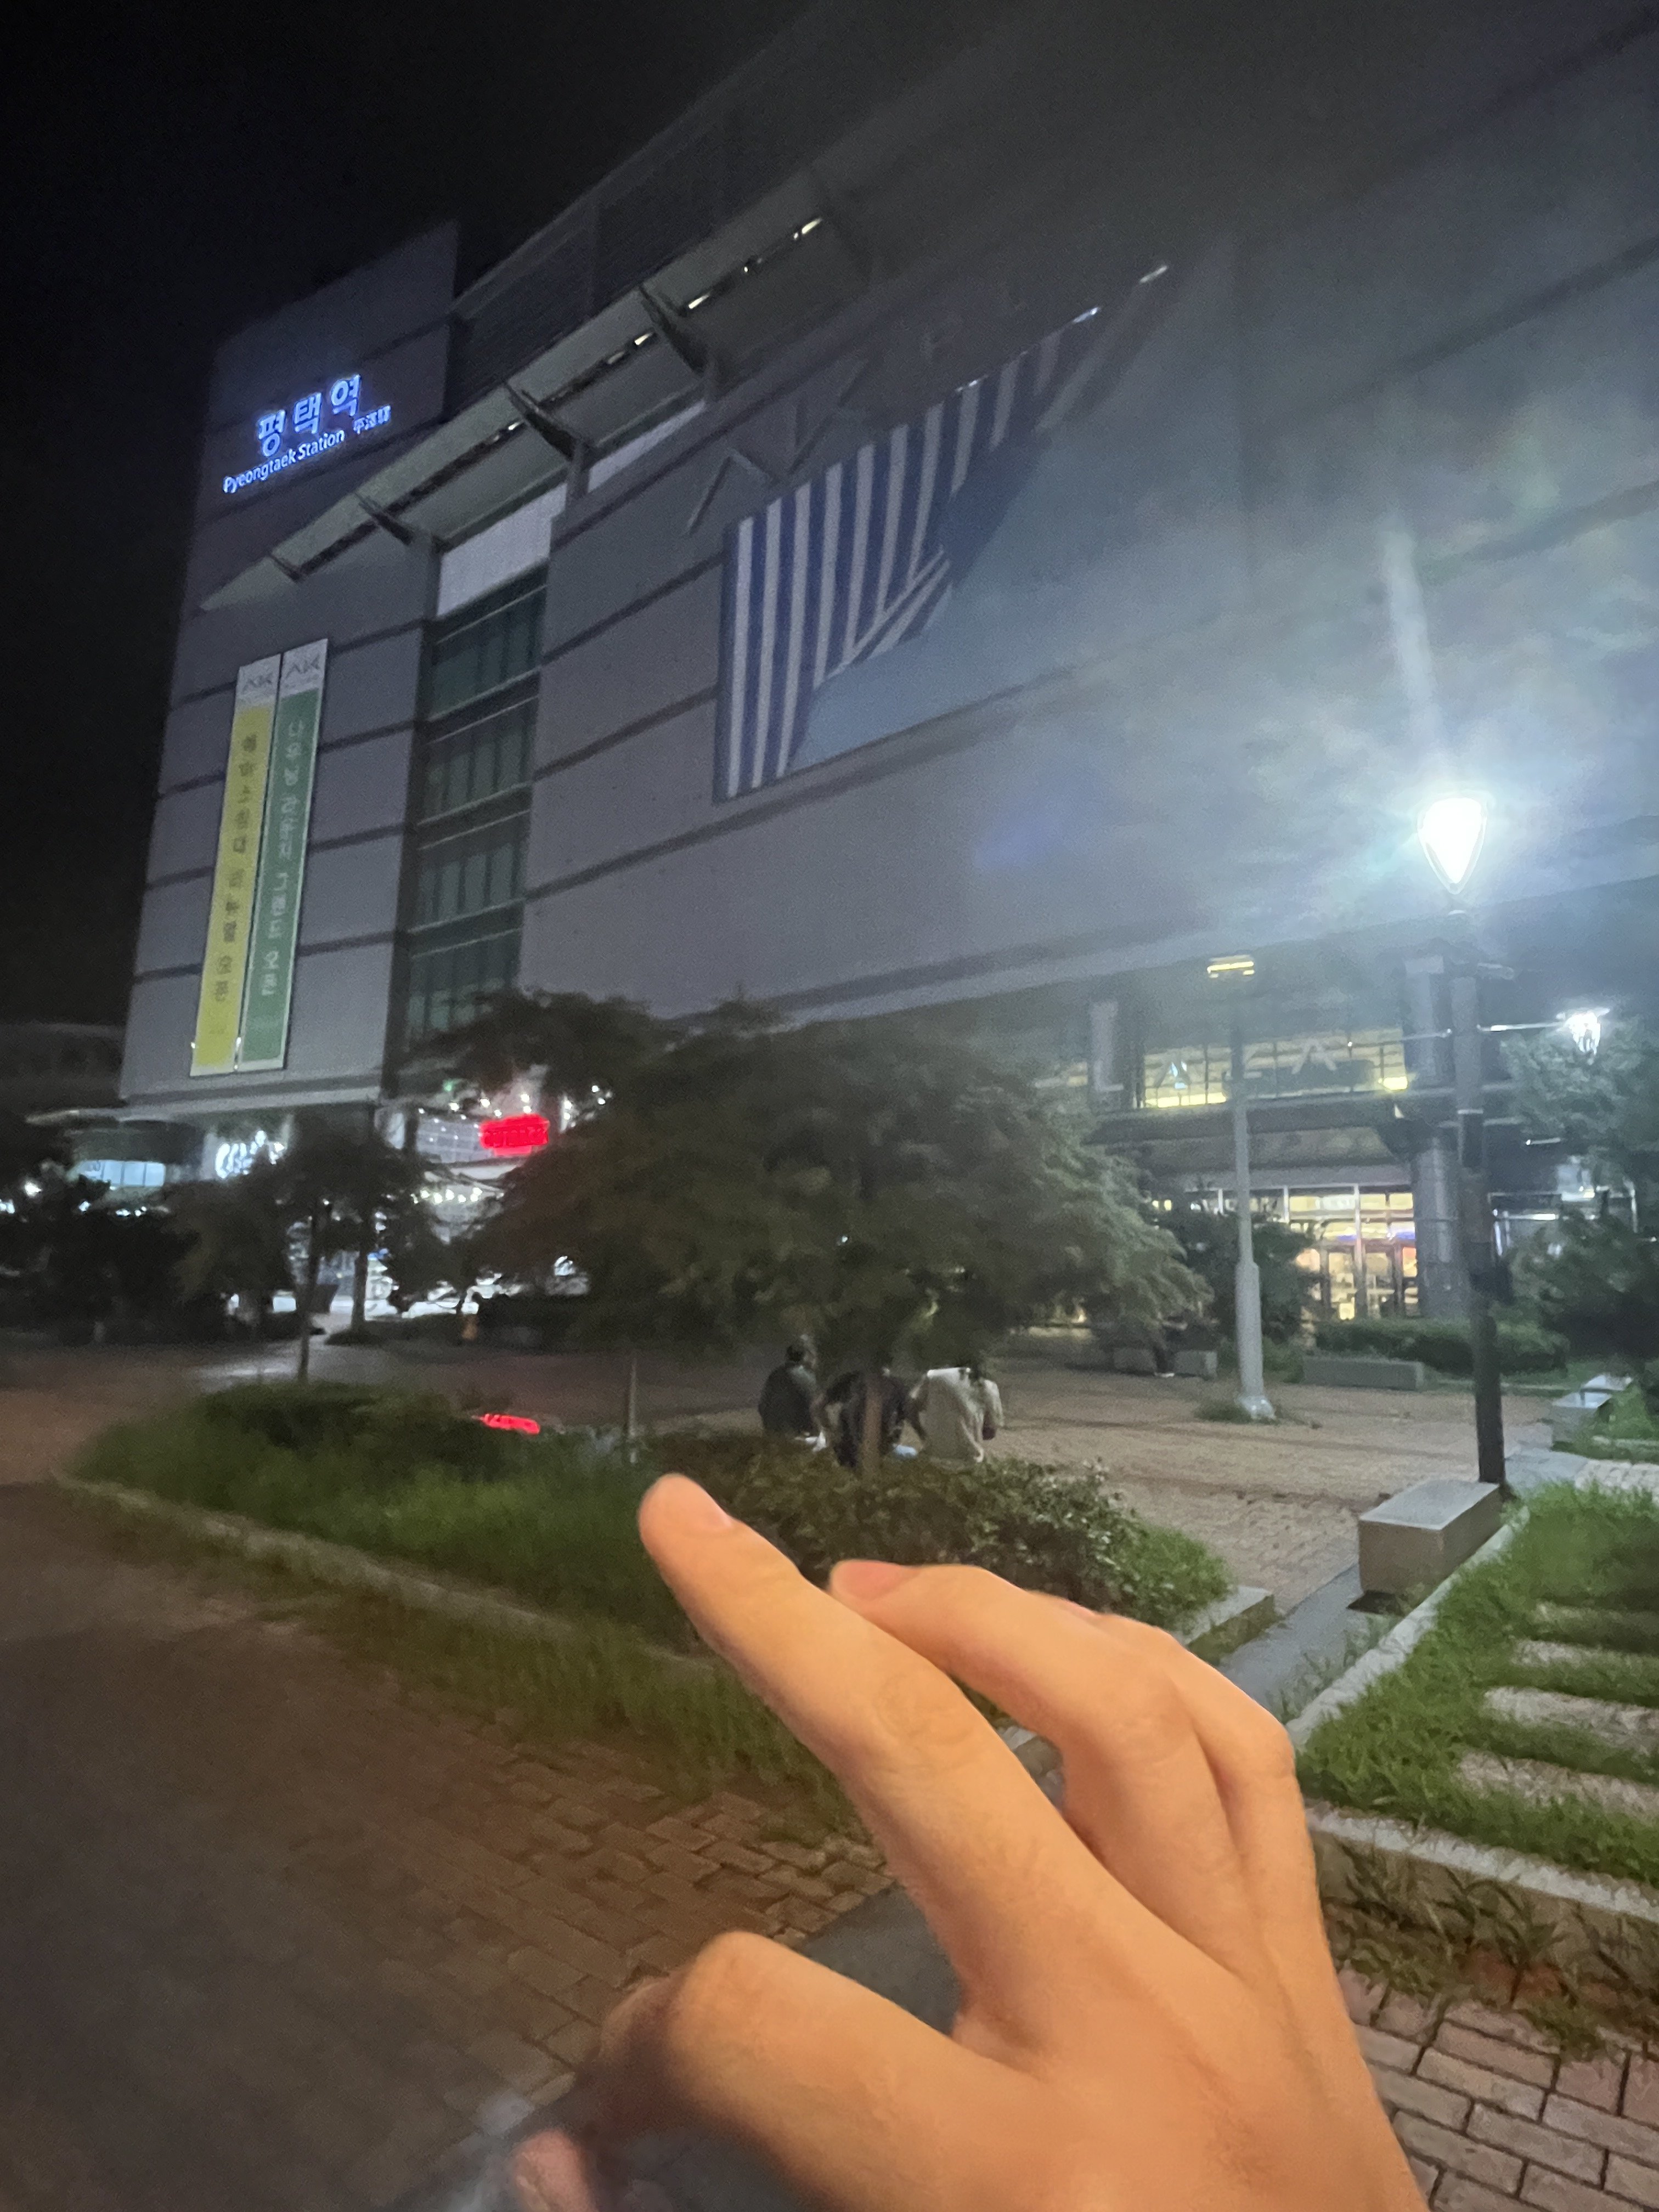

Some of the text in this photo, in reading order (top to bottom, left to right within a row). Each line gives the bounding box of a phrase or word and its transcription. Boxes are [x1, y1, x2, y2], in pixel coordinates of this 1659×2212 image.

[258, 374, 361, 457] 평택역
[223, 430, 345, 493] Pyeongtaek Station
